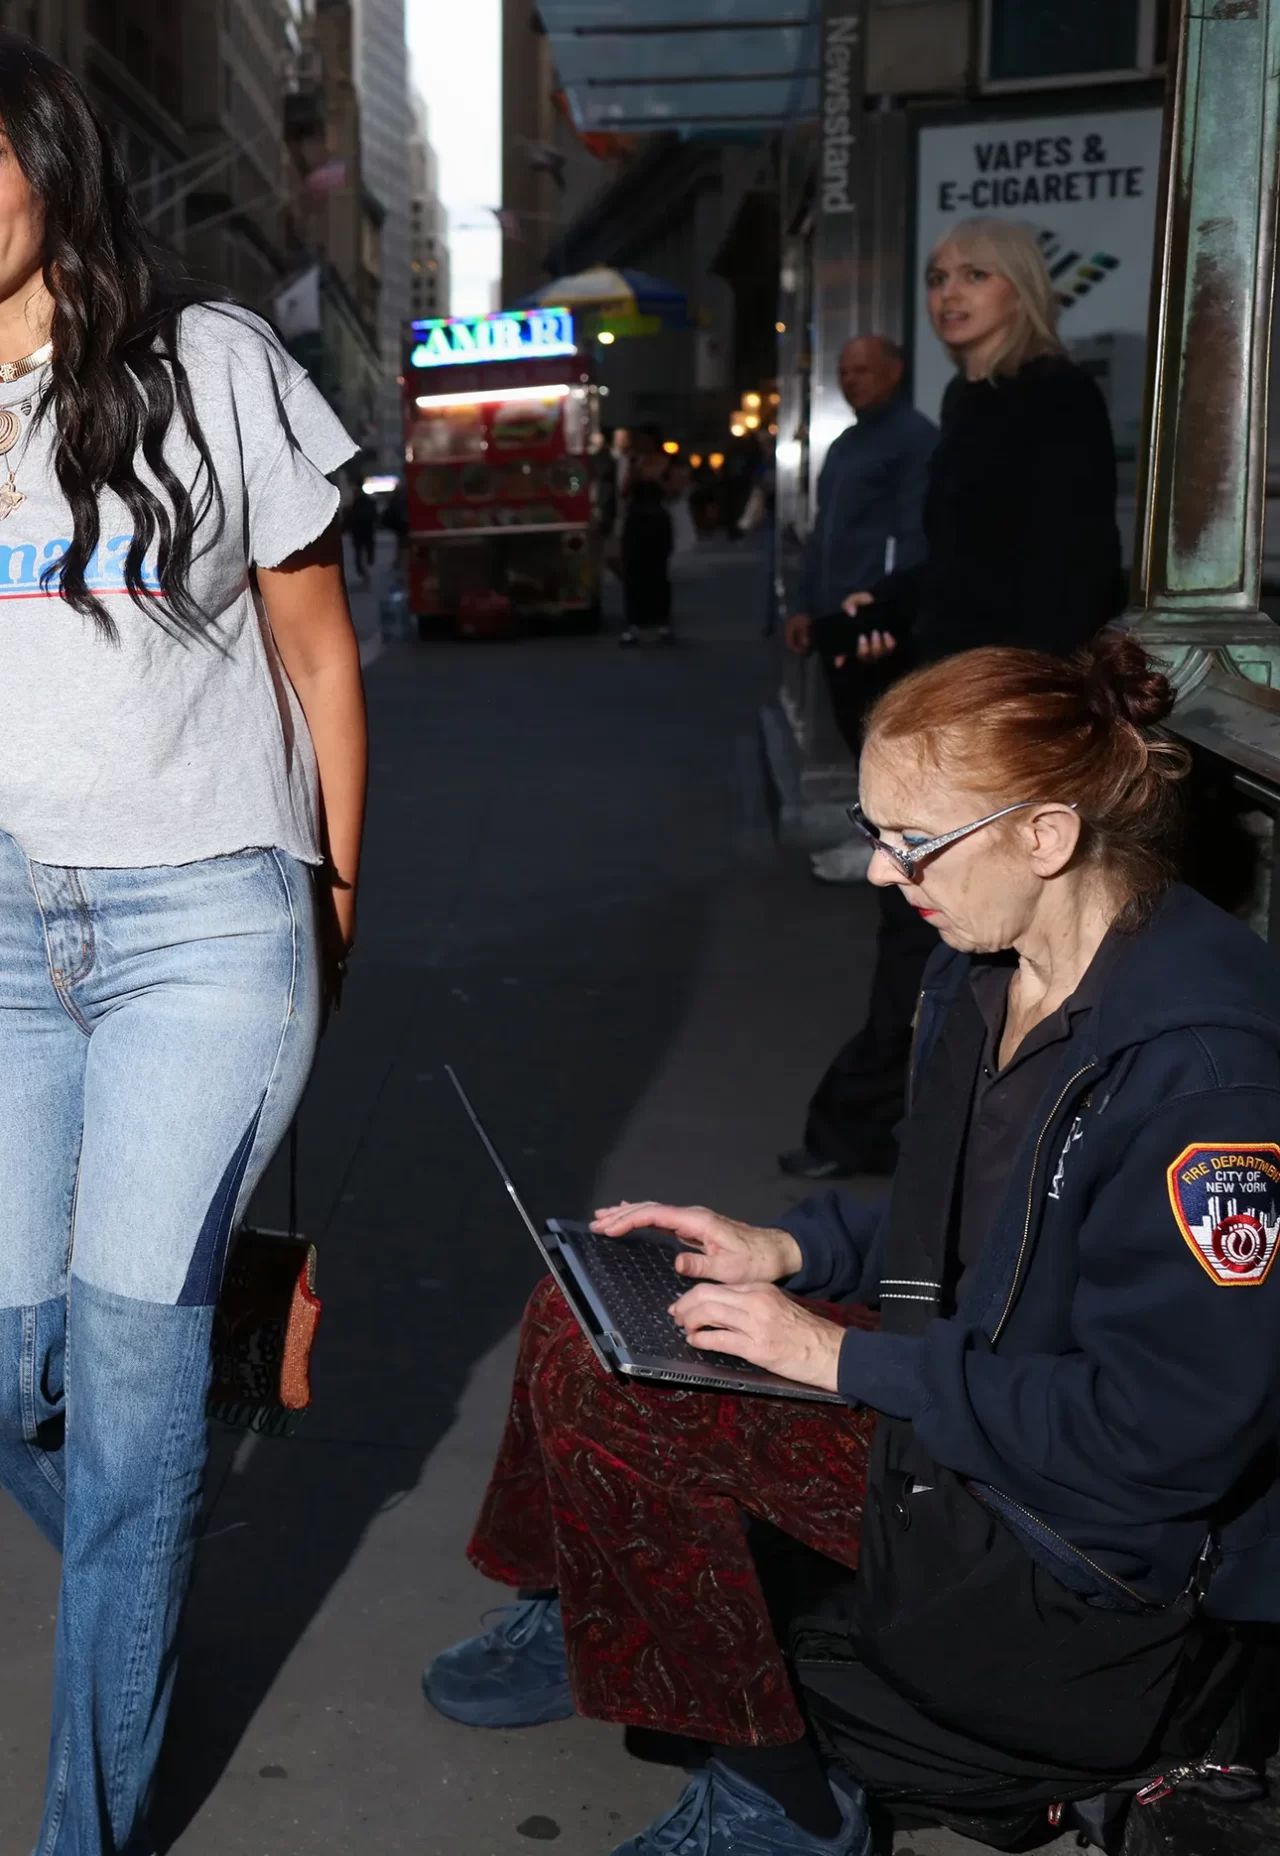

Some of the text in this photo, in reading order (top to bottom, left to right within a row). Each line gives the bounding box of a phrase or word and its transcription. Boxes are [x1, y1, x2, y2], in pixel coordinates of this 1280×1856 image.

[823, 16, 859, 214] Newsstand
[974, 132, 1107, 172] VAPES &
[937, 166, 1144, 213] E-CIGARETTE
[1181, 1155, 1280, 1185] FIRE DEPARTMEN
[1206, 1182, 1267, 1193] NEW YORK
[1215, 1171, 1261, 1182] CITY OF
